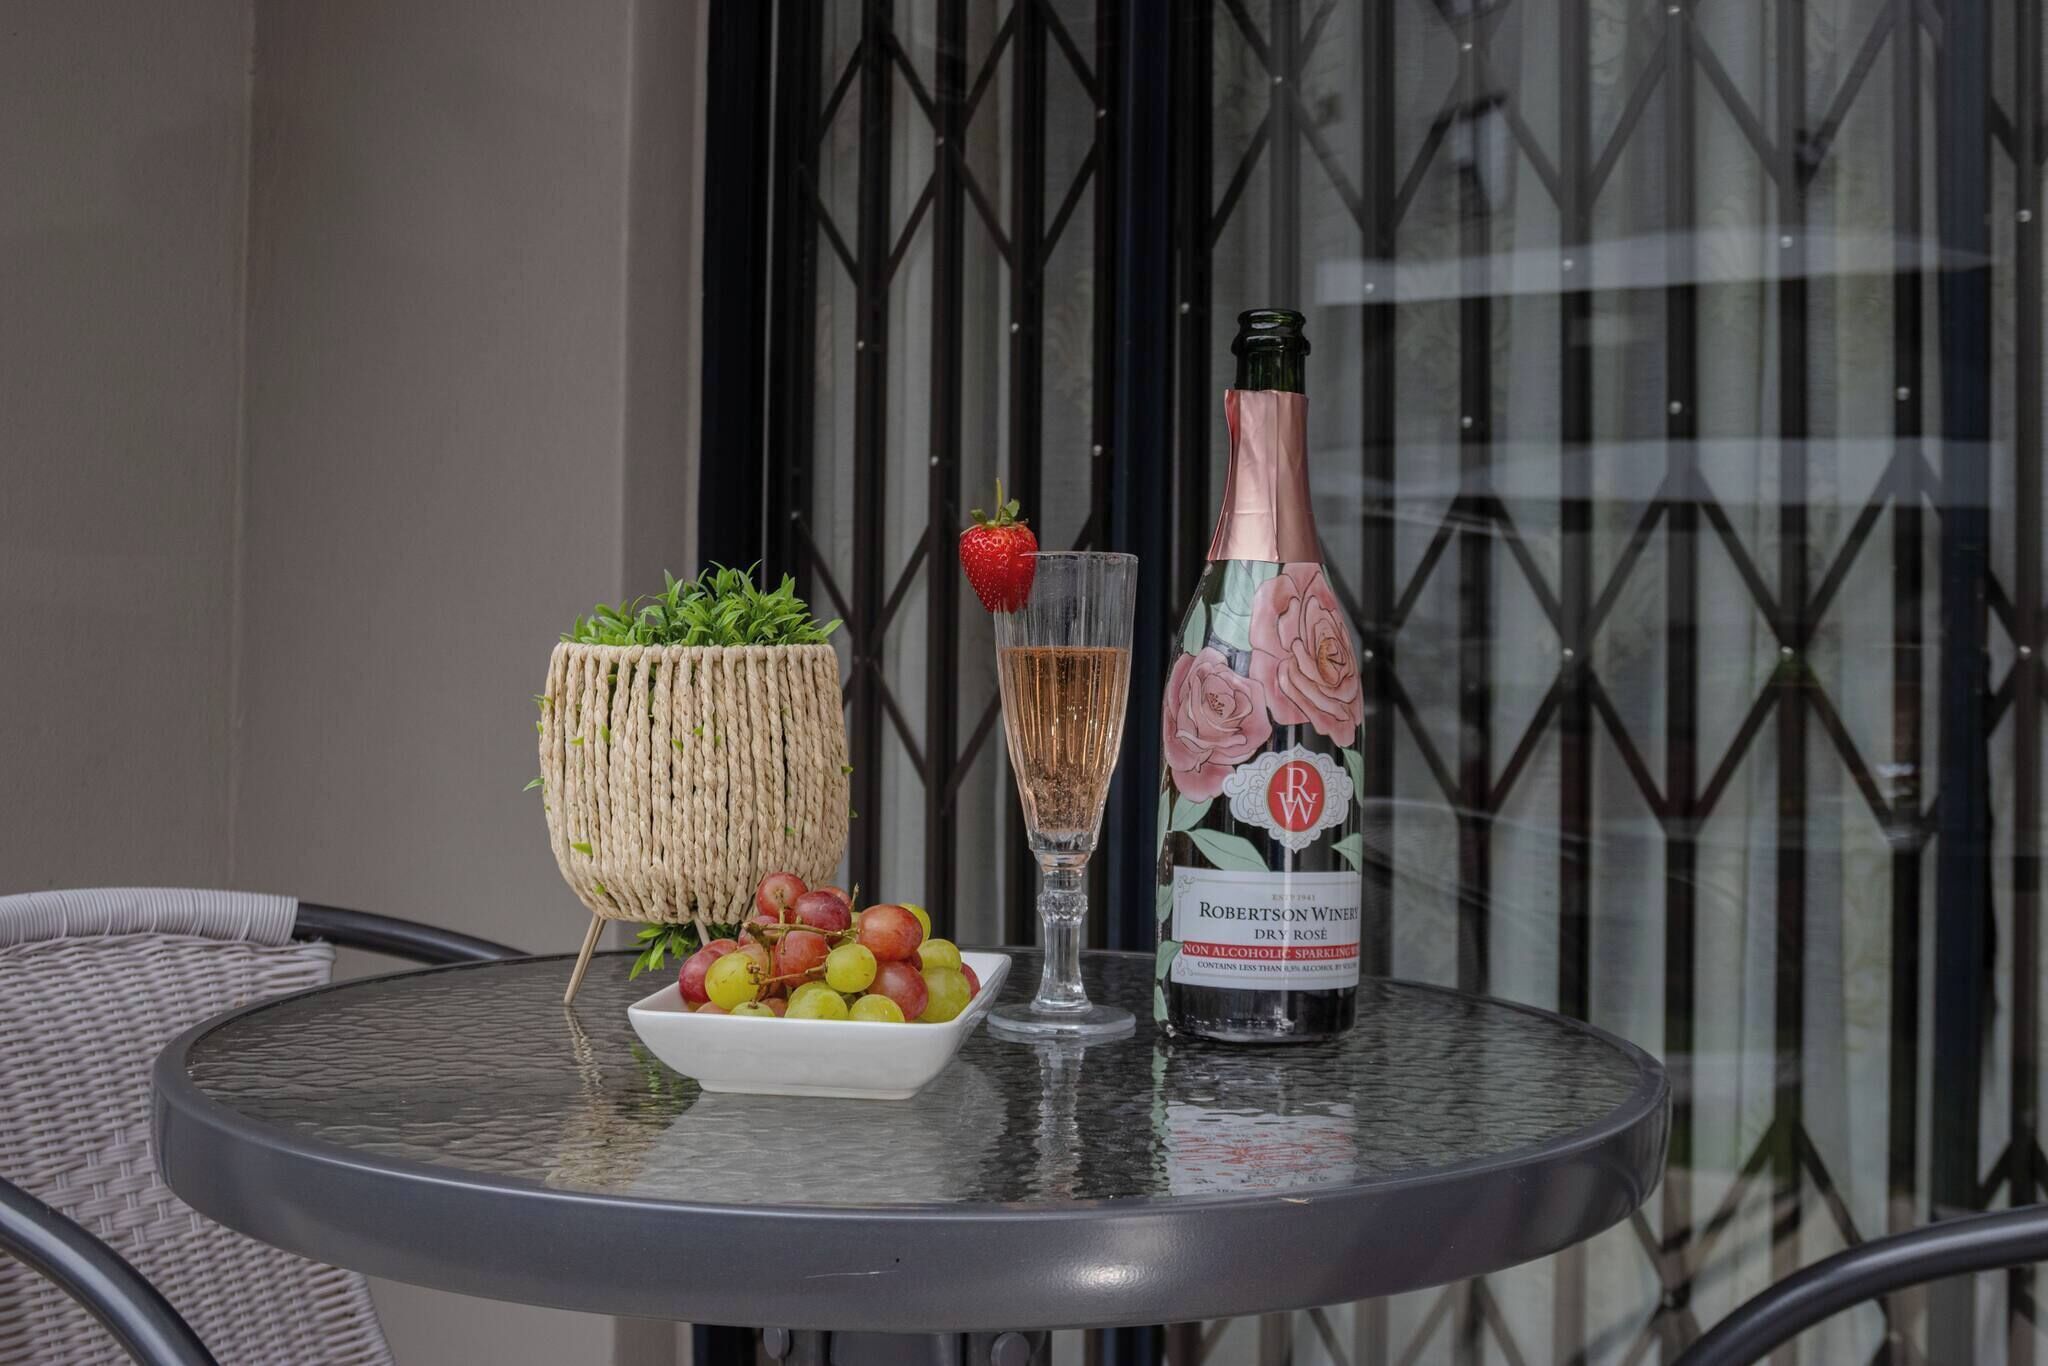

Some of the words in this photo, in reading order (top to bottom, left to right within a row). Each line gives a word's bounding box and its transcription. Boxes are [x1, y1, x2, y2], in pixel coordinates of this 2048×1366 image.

[1199, 901, 1308, 922] ROBERTSON
[1311, 905, 1358, 921] WINERY
[1255, 928, 1287, 940] DRY
[1294, 926, 1328, 940] ROSÉ
[1183, 943, 1209, 956] NON
[1212, 946, 1291, 959] ALCOHOLIC
[1295, 946, 1351, 959] SPARKLING
[1197, 960, 1237, 971] CONTAINS
[1239, 963, 1257, 972] LESS
[1259, 964, 1282, 973] THAN
